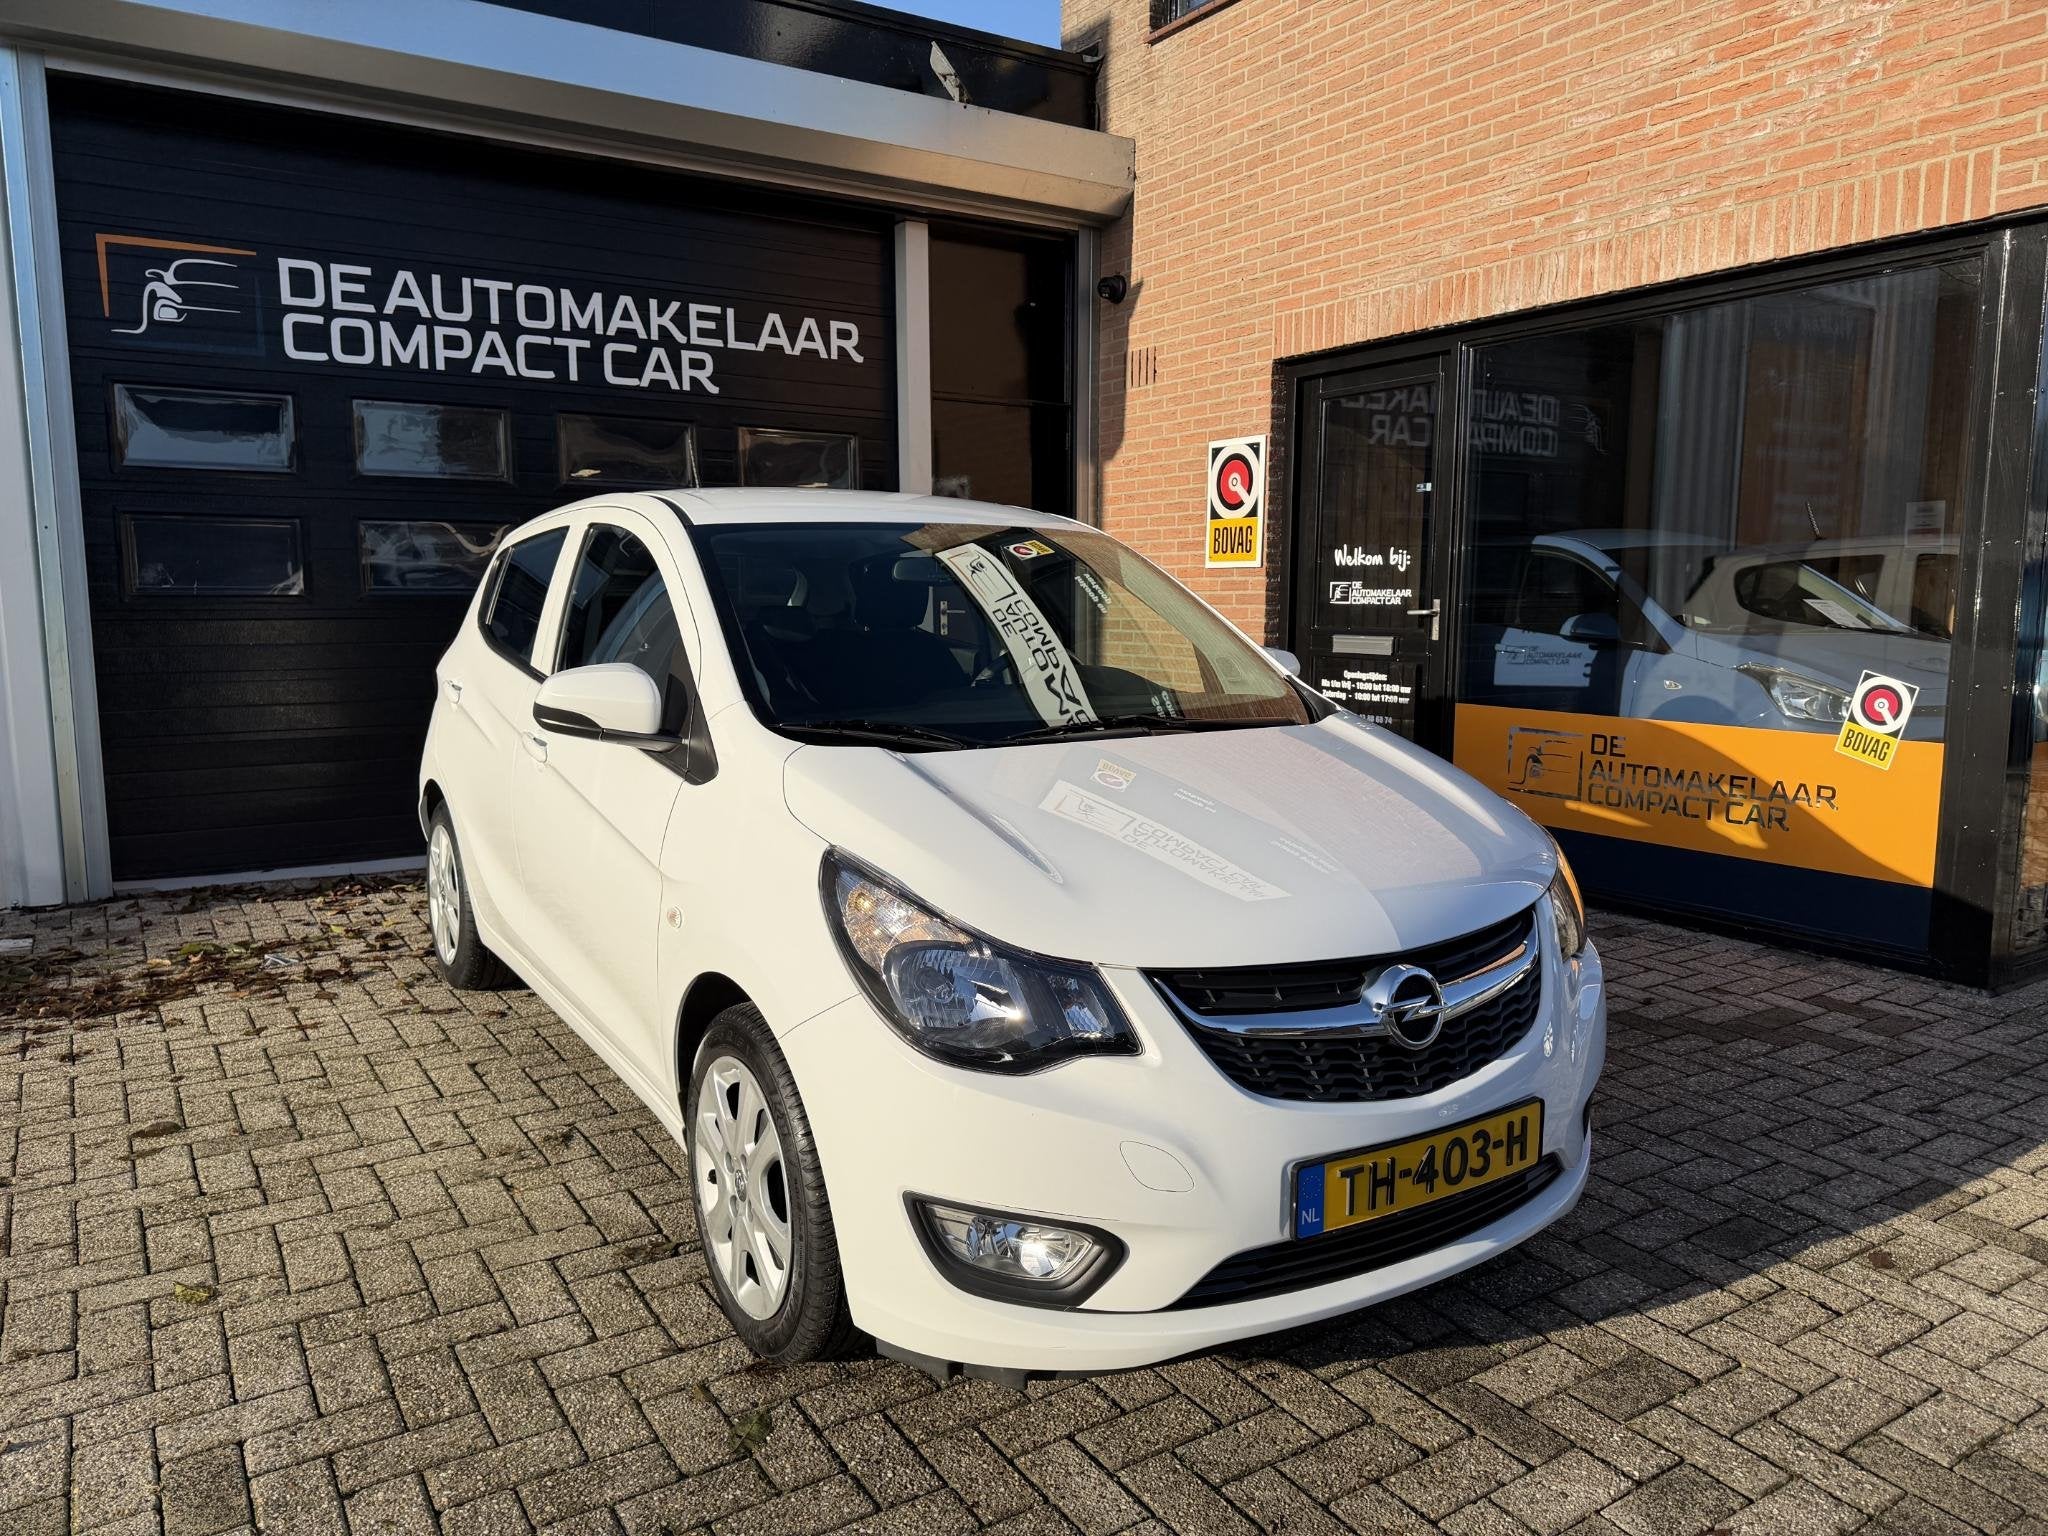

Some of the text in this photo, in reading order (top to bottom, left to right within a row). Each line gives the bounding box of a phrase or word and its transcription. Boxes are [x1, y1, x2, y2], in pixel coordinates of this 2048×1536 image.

[277, 257, 865, 363] DE AUTOMAKELAAR
[282, 313, 720, 394] COMPACT CAR
[1213, 525, 1253, 555] BOVAG
[1334, 544, 1412, 572] Welkom bij:
[1351, 581, 1363, 589] DE
[1351, 589, 1413, 598] AUTOMAKELAAR
[1351, 597, 1402, 605] COMPACT CAR
[1590, 733, 1626, 758] DE
[1842, 727, 1891, 762] BOVAG
[1588, 759, 1839, 811] AUTOMAKELAAR
[1587, 783, 1790, 832] COMPACT CAR
[1337, 1116, 1529, 1217] TH-403-H
[1301, 1207, 1320, 1225] NL
